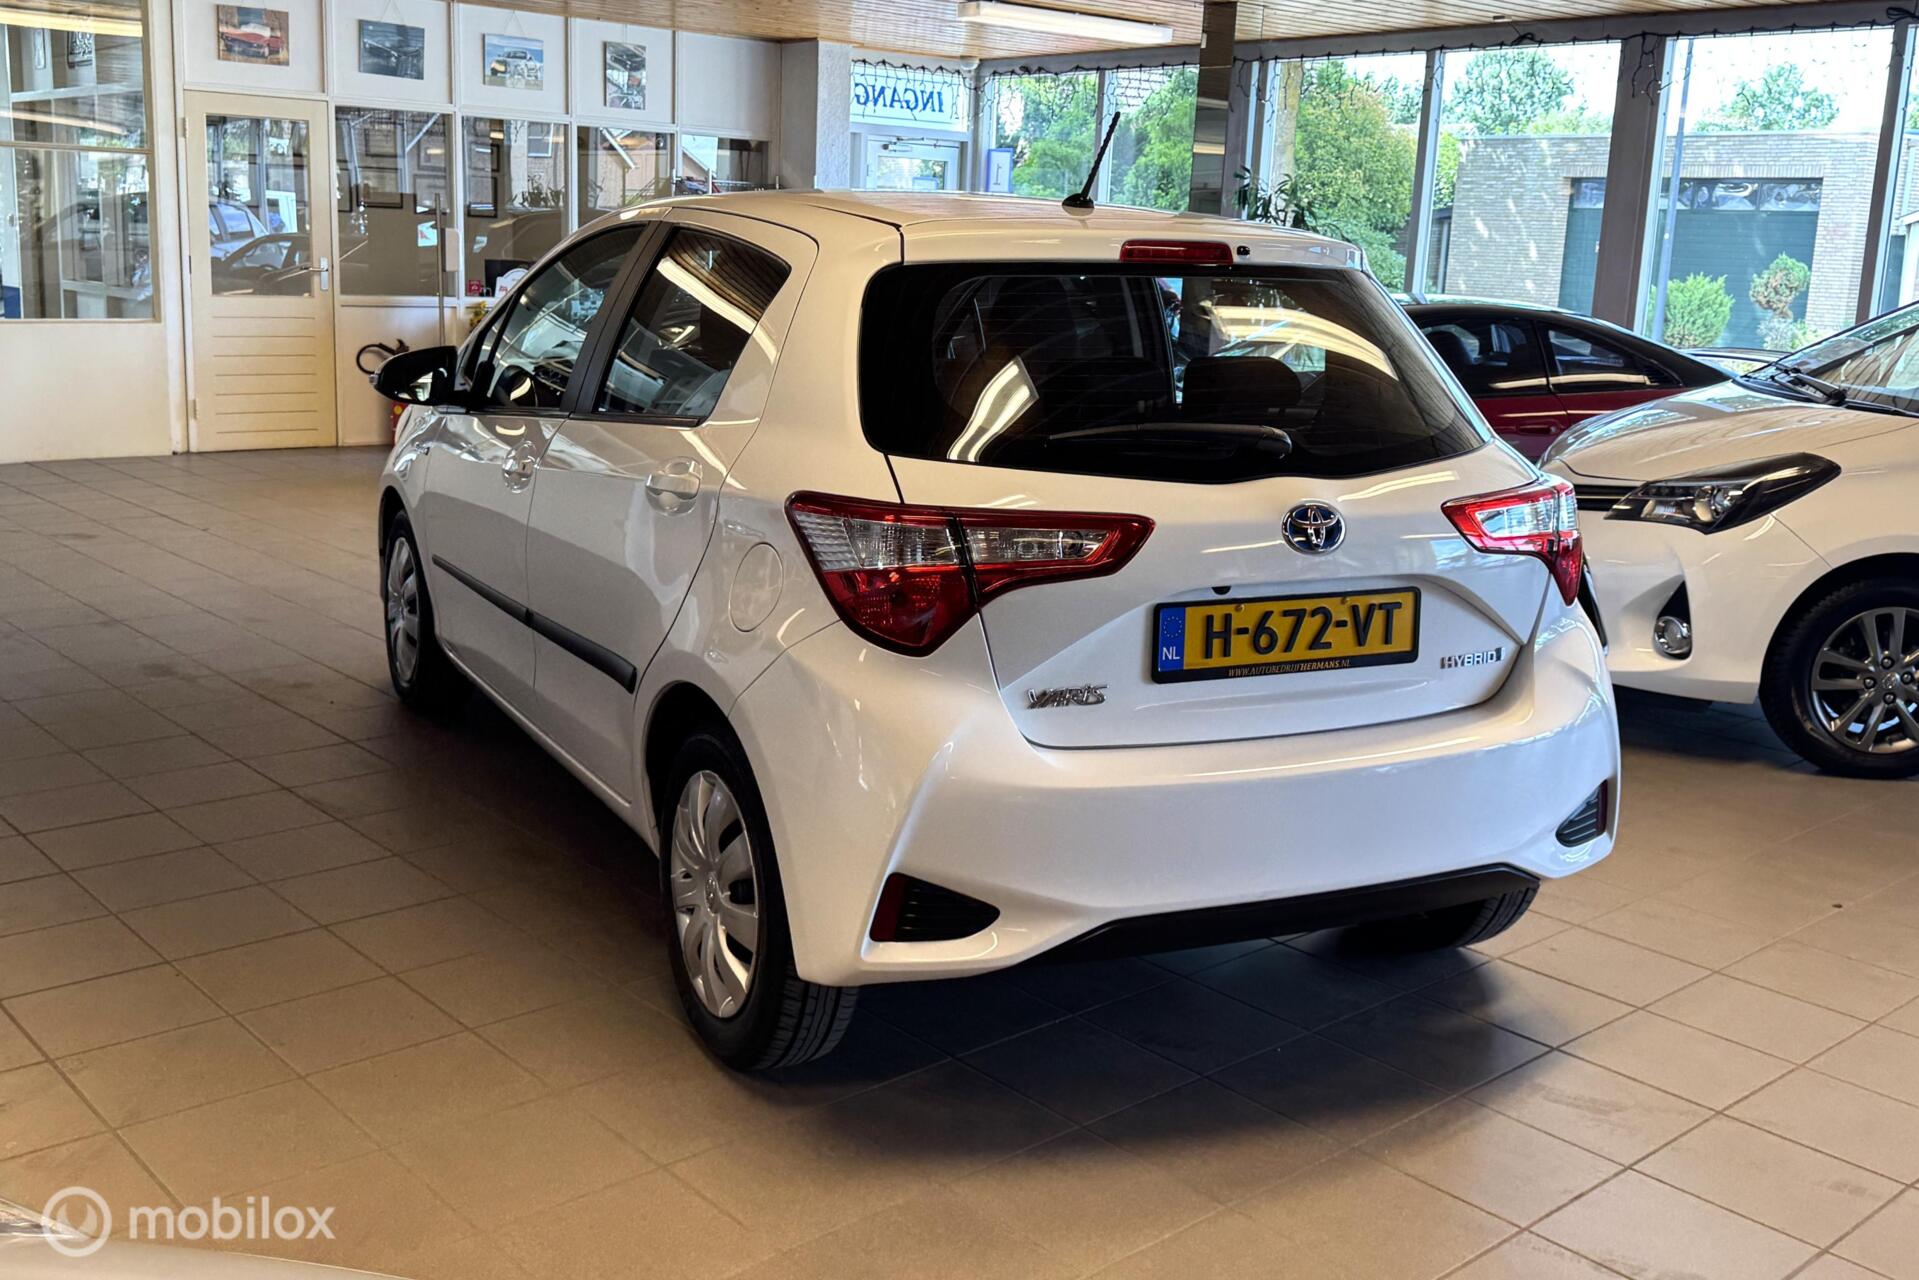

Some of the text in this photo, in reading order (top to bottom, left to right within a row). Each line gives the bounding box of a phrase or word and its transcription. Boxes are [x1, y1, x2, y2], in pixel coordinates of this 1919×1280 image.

[1204, 602, 1402, 659] H-672-VT
[1162, 646, 1180, 661] NL
[1440, 650, 1499, 669] HYBRID
